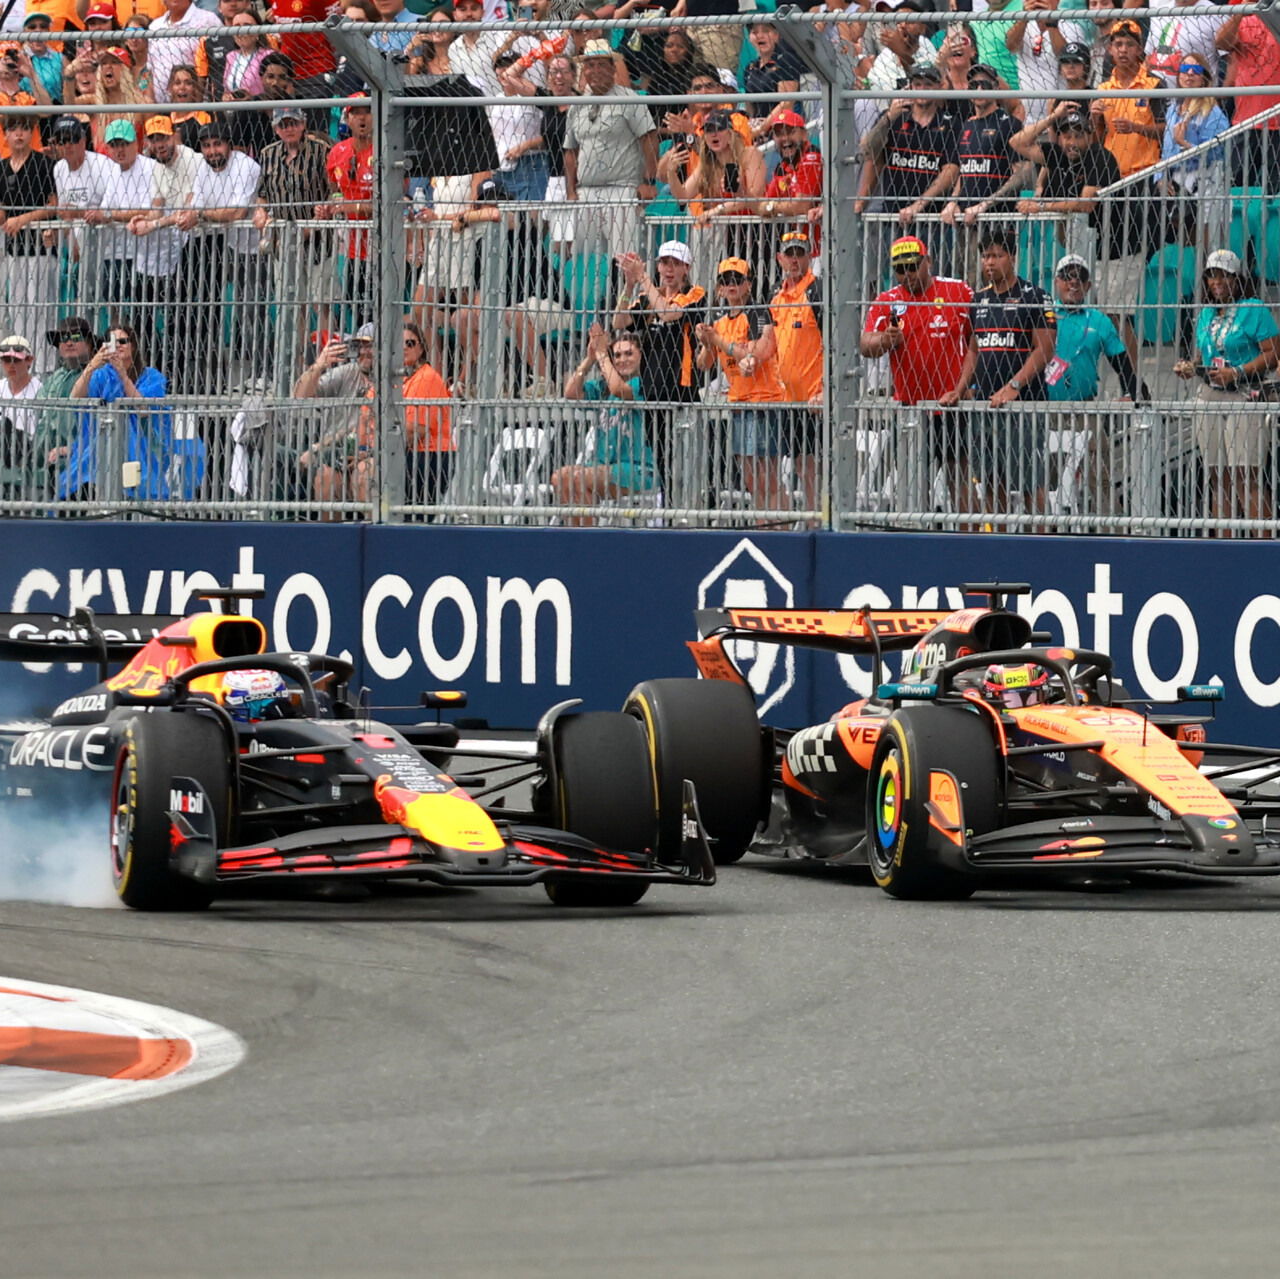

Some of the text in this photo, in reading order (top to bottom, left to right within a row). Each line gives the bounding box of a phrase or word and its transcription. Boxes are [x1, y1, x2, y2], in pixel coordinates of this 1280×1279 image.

[897, 685, 931, 697] allwyn
[52, 694, 107, 717] HONDA
[9, 726, 115, 772] ORACLE
[170, 789, 204, 814] Mobil
